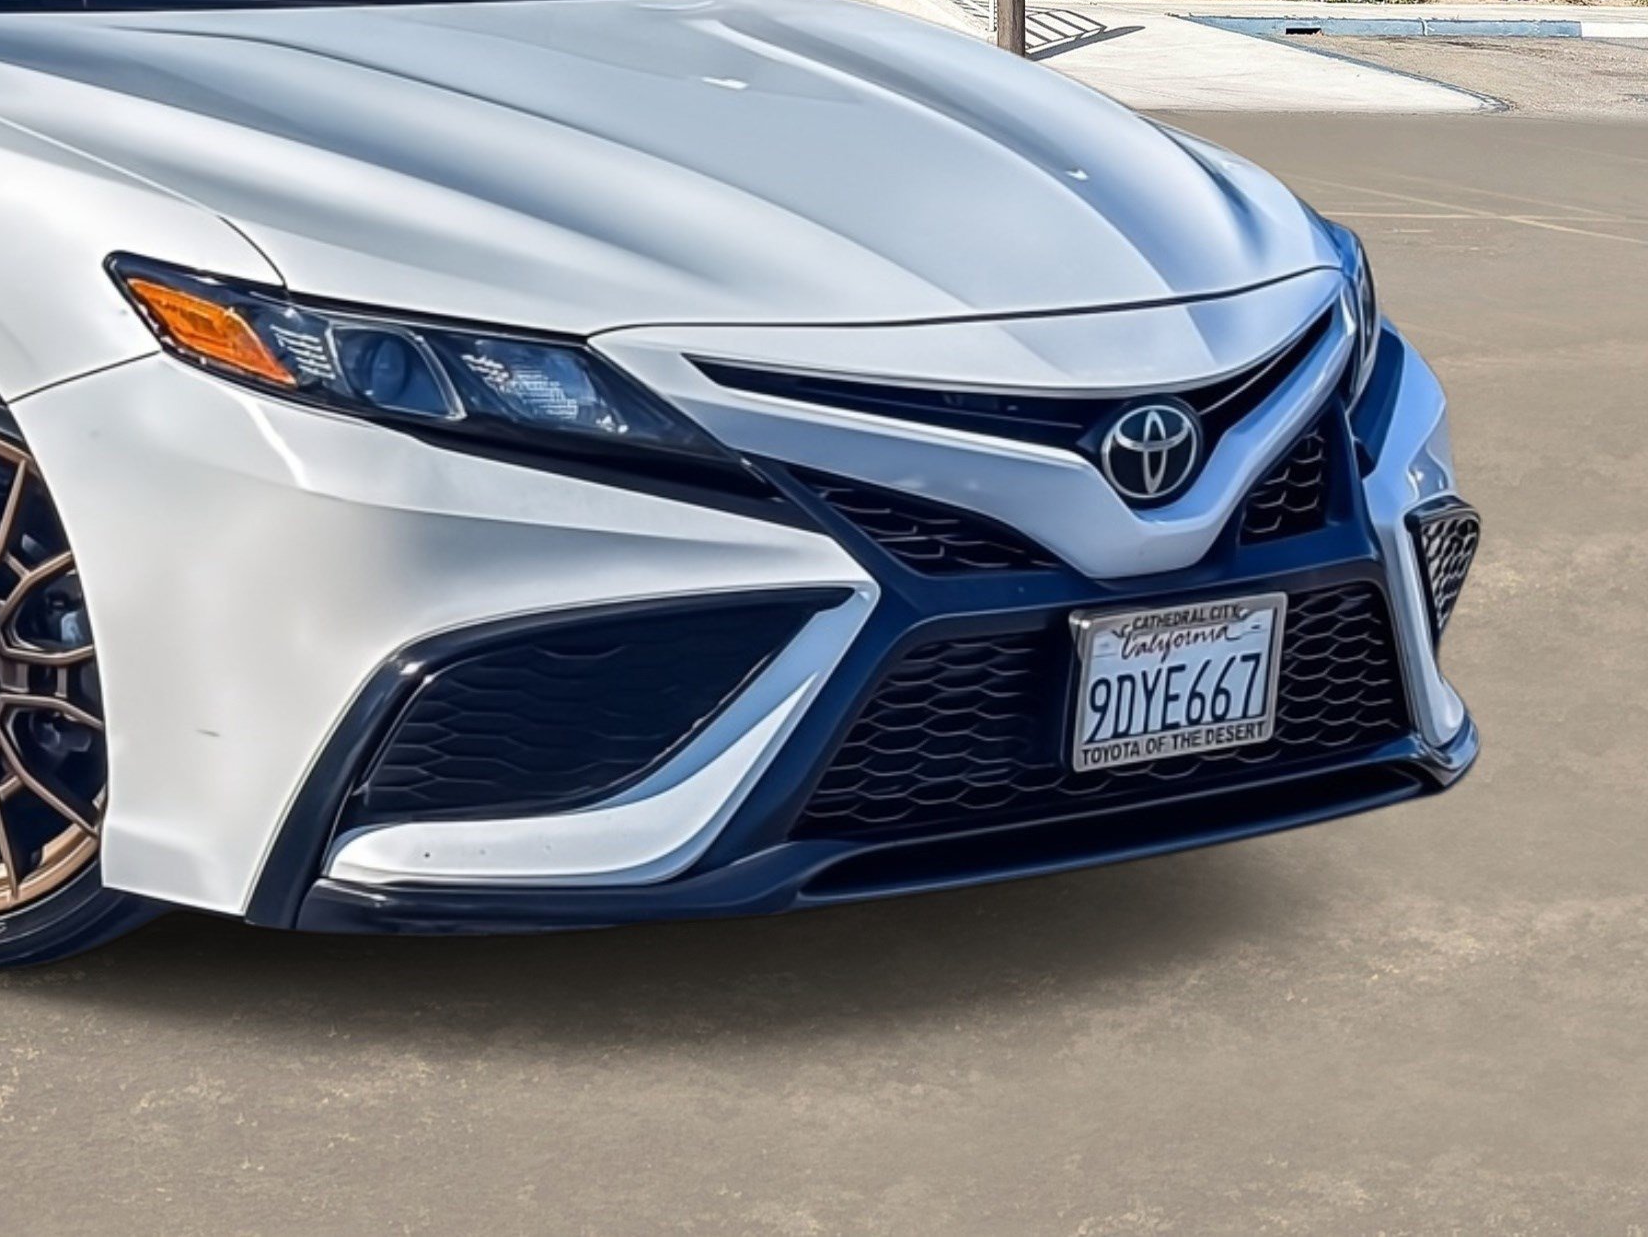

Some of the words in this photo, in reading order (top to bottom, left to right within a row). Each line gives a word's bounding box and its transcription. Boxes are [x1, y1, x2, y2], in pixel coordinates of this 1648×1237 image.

[1131, 608, 1204, 630] CATHEDRAL
[1211, 604, 1241, 621] CITY
[1115, 623, 1242, 663] California
[1084, 652, 1263, 744] 9DYE667
[1082, 742, 1140, 765] TOYOTA
[1146, 735, 1166, 753] OF
[1172, 730, 1201, 749] THE
[1205, 721, 1266, 743] DESERT
